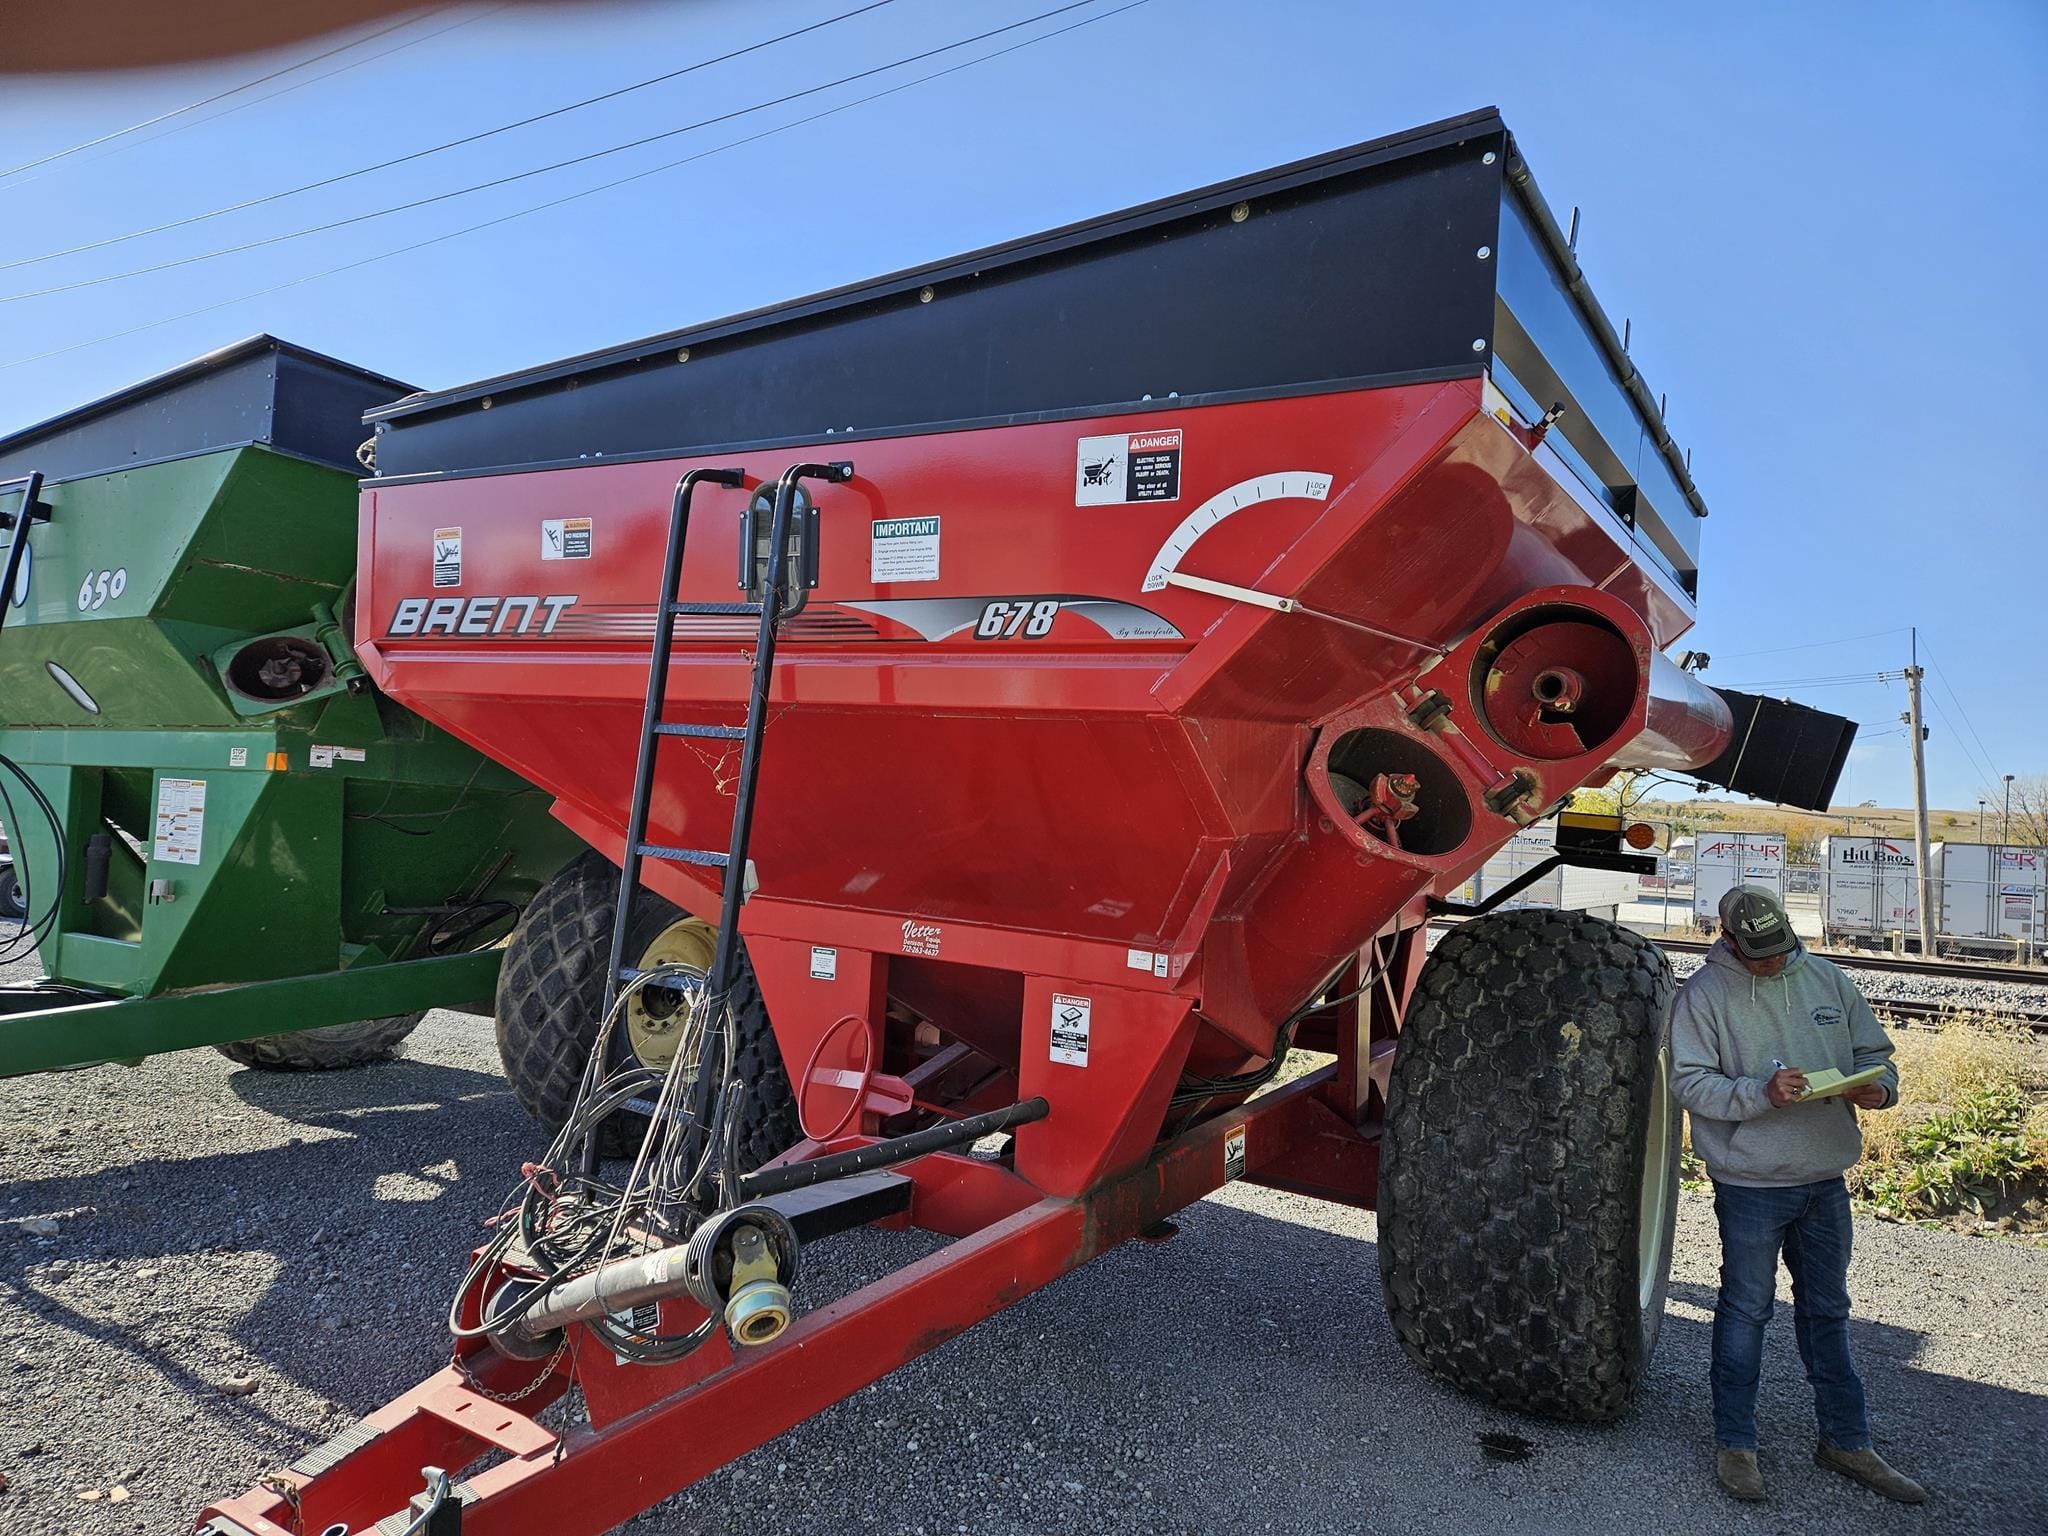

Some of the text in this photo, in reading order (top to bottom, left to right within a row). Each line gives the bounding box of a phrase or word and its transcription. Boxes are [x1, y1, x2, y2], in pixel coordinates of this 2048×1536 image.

[1140, 435, 1179, 448] DANGER
[1310, 481, 1326, 490] LOCK
[875, 520, 936, 537] IMPORTANT
[1147, 581, 1165, 589] DOWN
[1148, 574, 1163, 583] LOCK
[77, 567, 128, 613] 650
[387, 595, 579, 635] BRENT
[976, 600, 1060, 638] 678
[1116, 627, 1130, 638] By
[1843, 847, 1870, 861] Hill
[901, 919, 942, 939] Vetter
[902, 944, 940, 957] 712-263-4637
[1062, 998, 1089, 1008] DANGER
